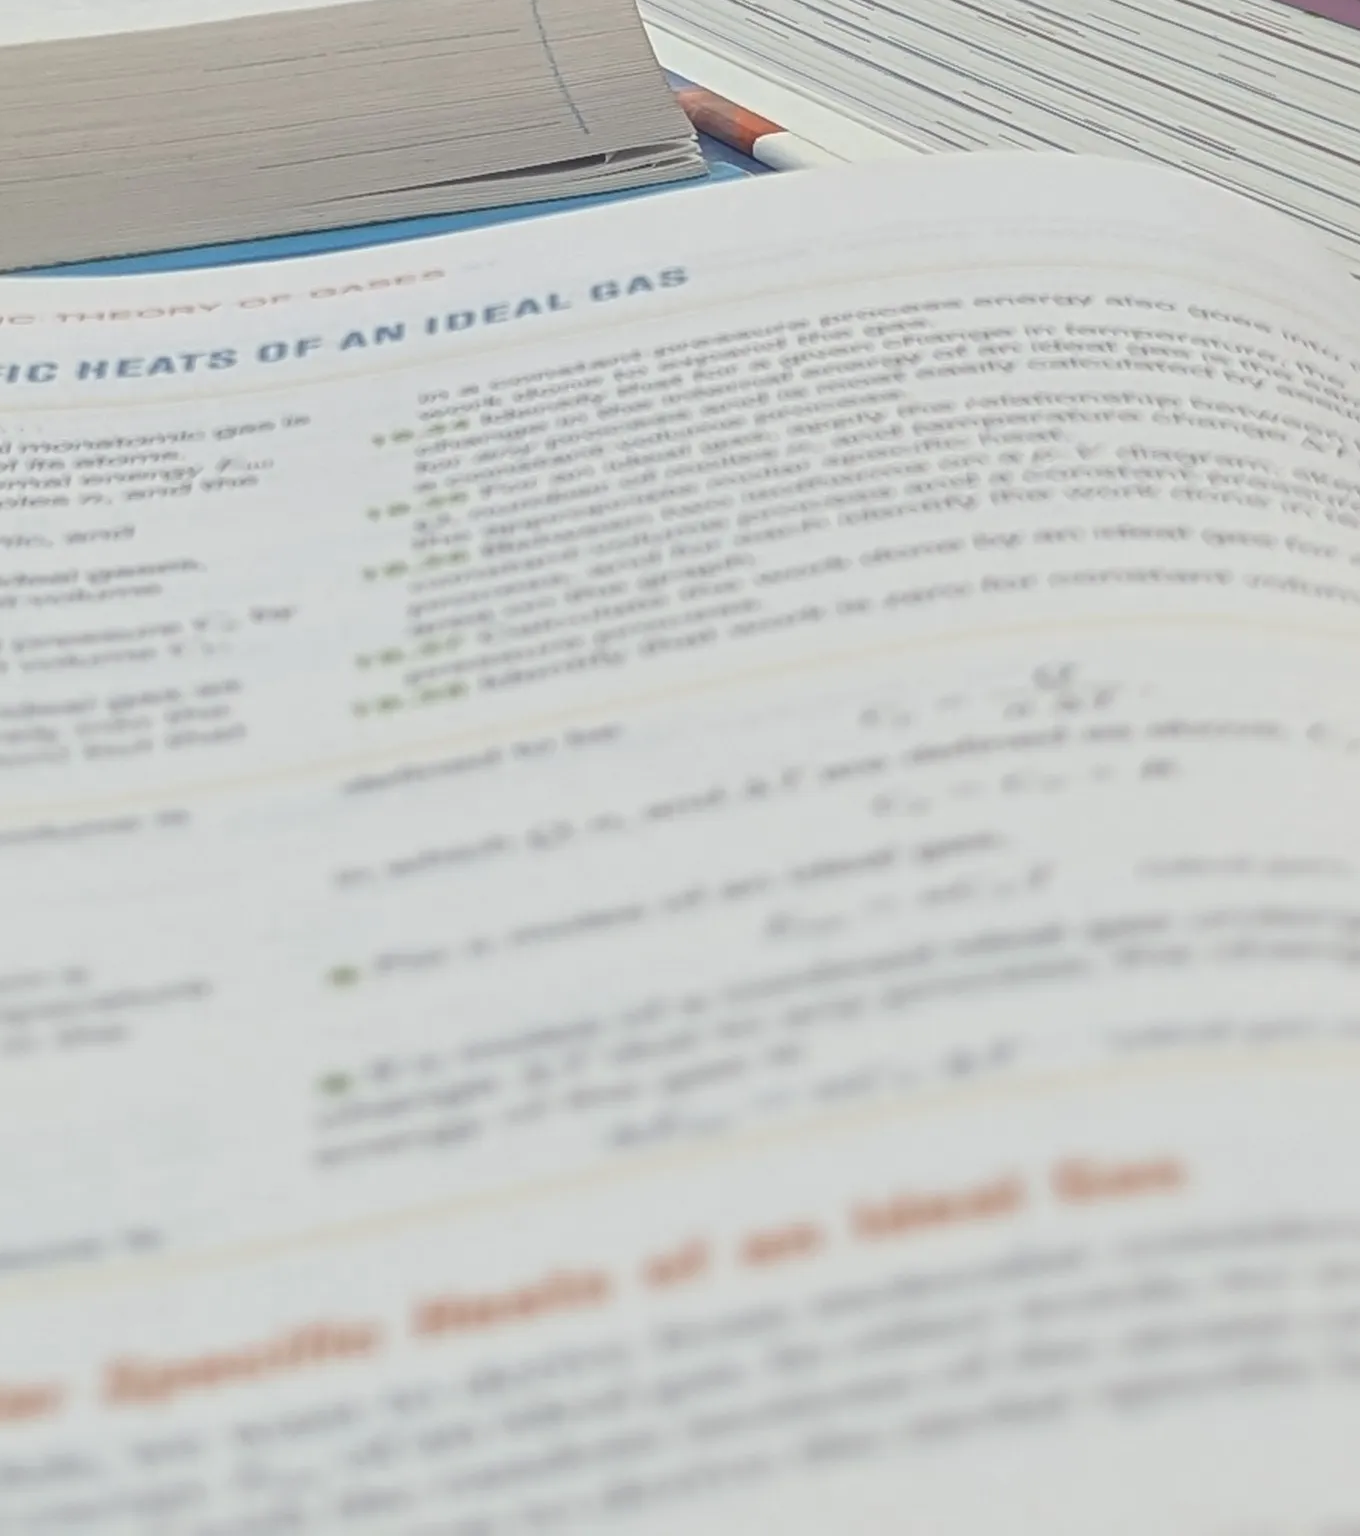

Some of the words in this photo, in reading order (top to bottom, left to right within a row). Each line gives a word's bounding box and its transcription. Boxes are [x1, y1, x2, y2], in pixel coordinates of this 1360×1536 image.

[56, 301, 222, 324] THEORY
[239, 292, 293, 309] OF
[76, 347, 239, 381] HEATS
[255, 335, 324, 364] OF
[339, 321, 407, 352] AN
[424, 292, 573, 335] IDEAL
[589, 265, 690, 303] GAS
